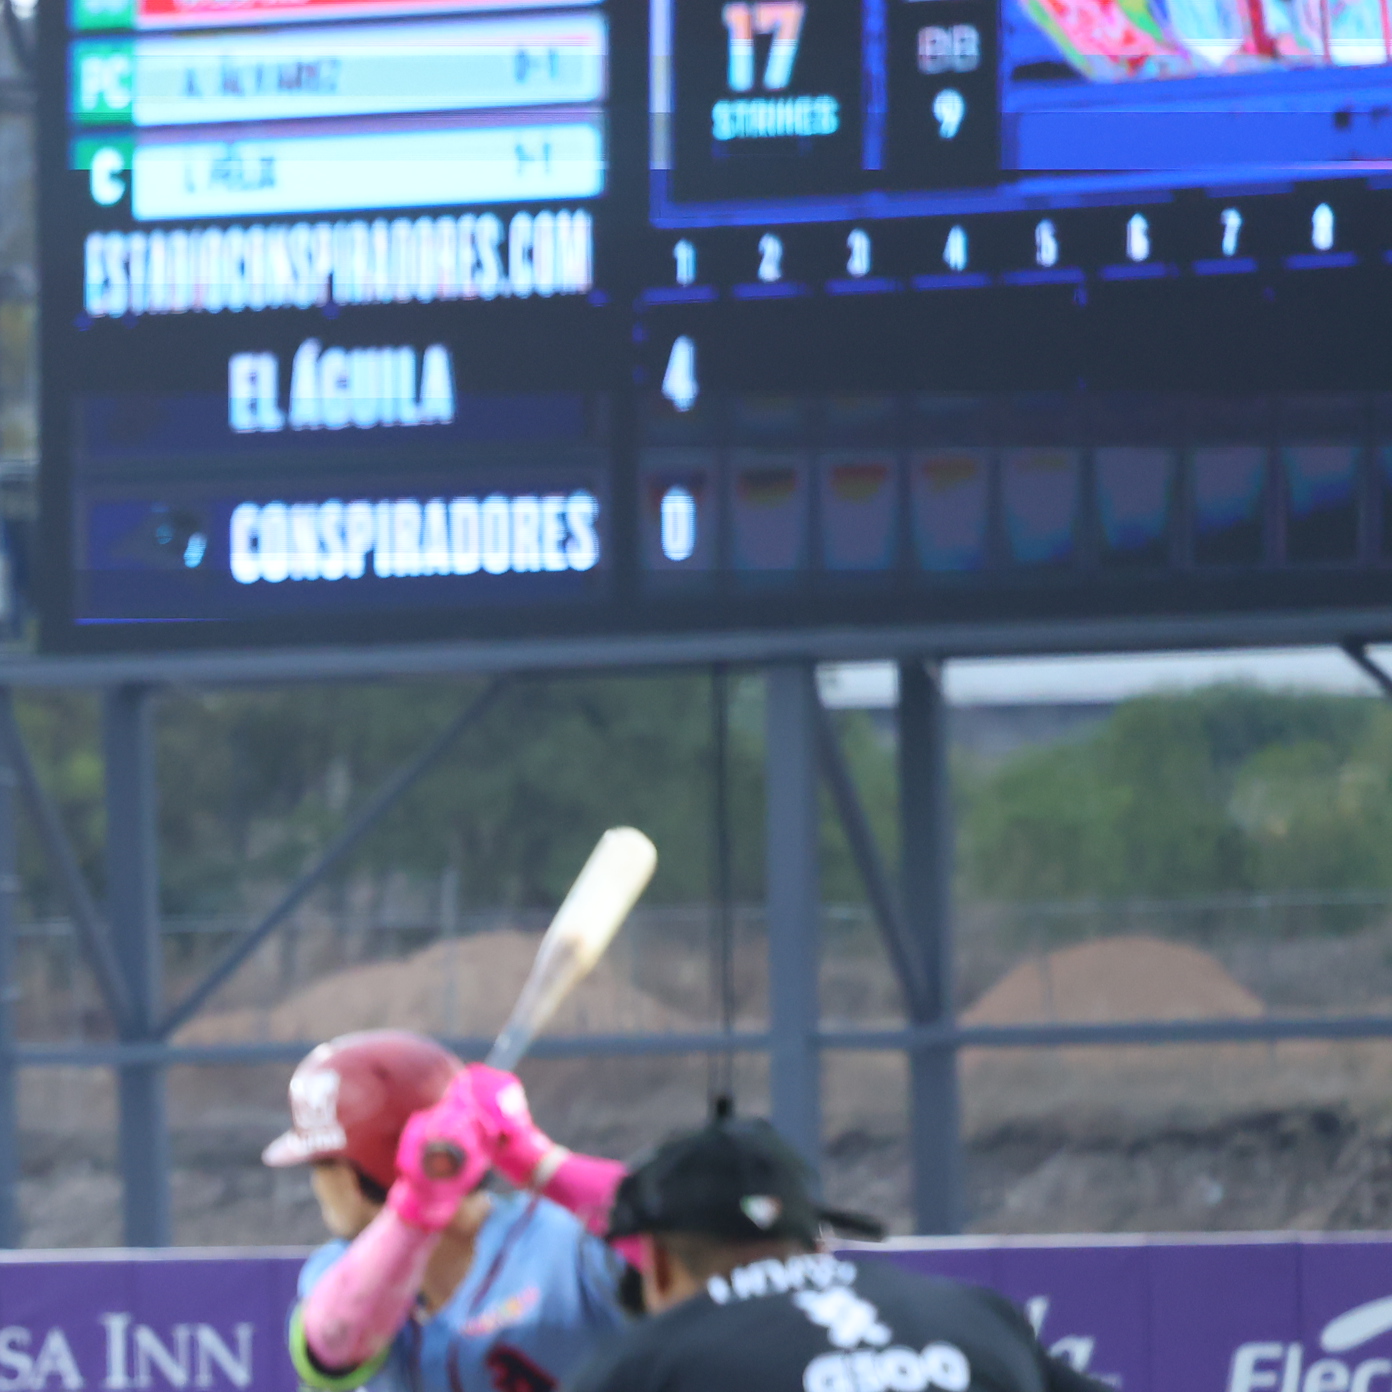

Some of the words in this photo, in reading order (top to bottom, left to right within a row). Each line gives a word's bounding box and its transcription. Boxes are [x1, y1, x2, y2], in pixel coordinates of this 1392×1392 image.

[721, 1, 807, 91] 17
[711, 95, 839, 140] STRIKES
[933, 88, 965, 138] 9
[90, 147, 126, 206] C
[673, 238, 697, 287] 1
[757, 232, 784, 284] 2
[846, 227, 872, 279] 3
[942, 223, 969, 273] 4
[1034, 218, 1060, 268] 5
[1126, 212, 1152, 263] 6
[1220, 207, 1243, 258] 7
[1312, 202, 1336, 251] 8
[228, 350, 284, 433] EL
[288, 338, 455, 430] ÁGUILA
[661, 335, 699, 412] 4
[229, 488, 600, 584] CONSPIRADORES
[660, 486, 697, 562] 0
